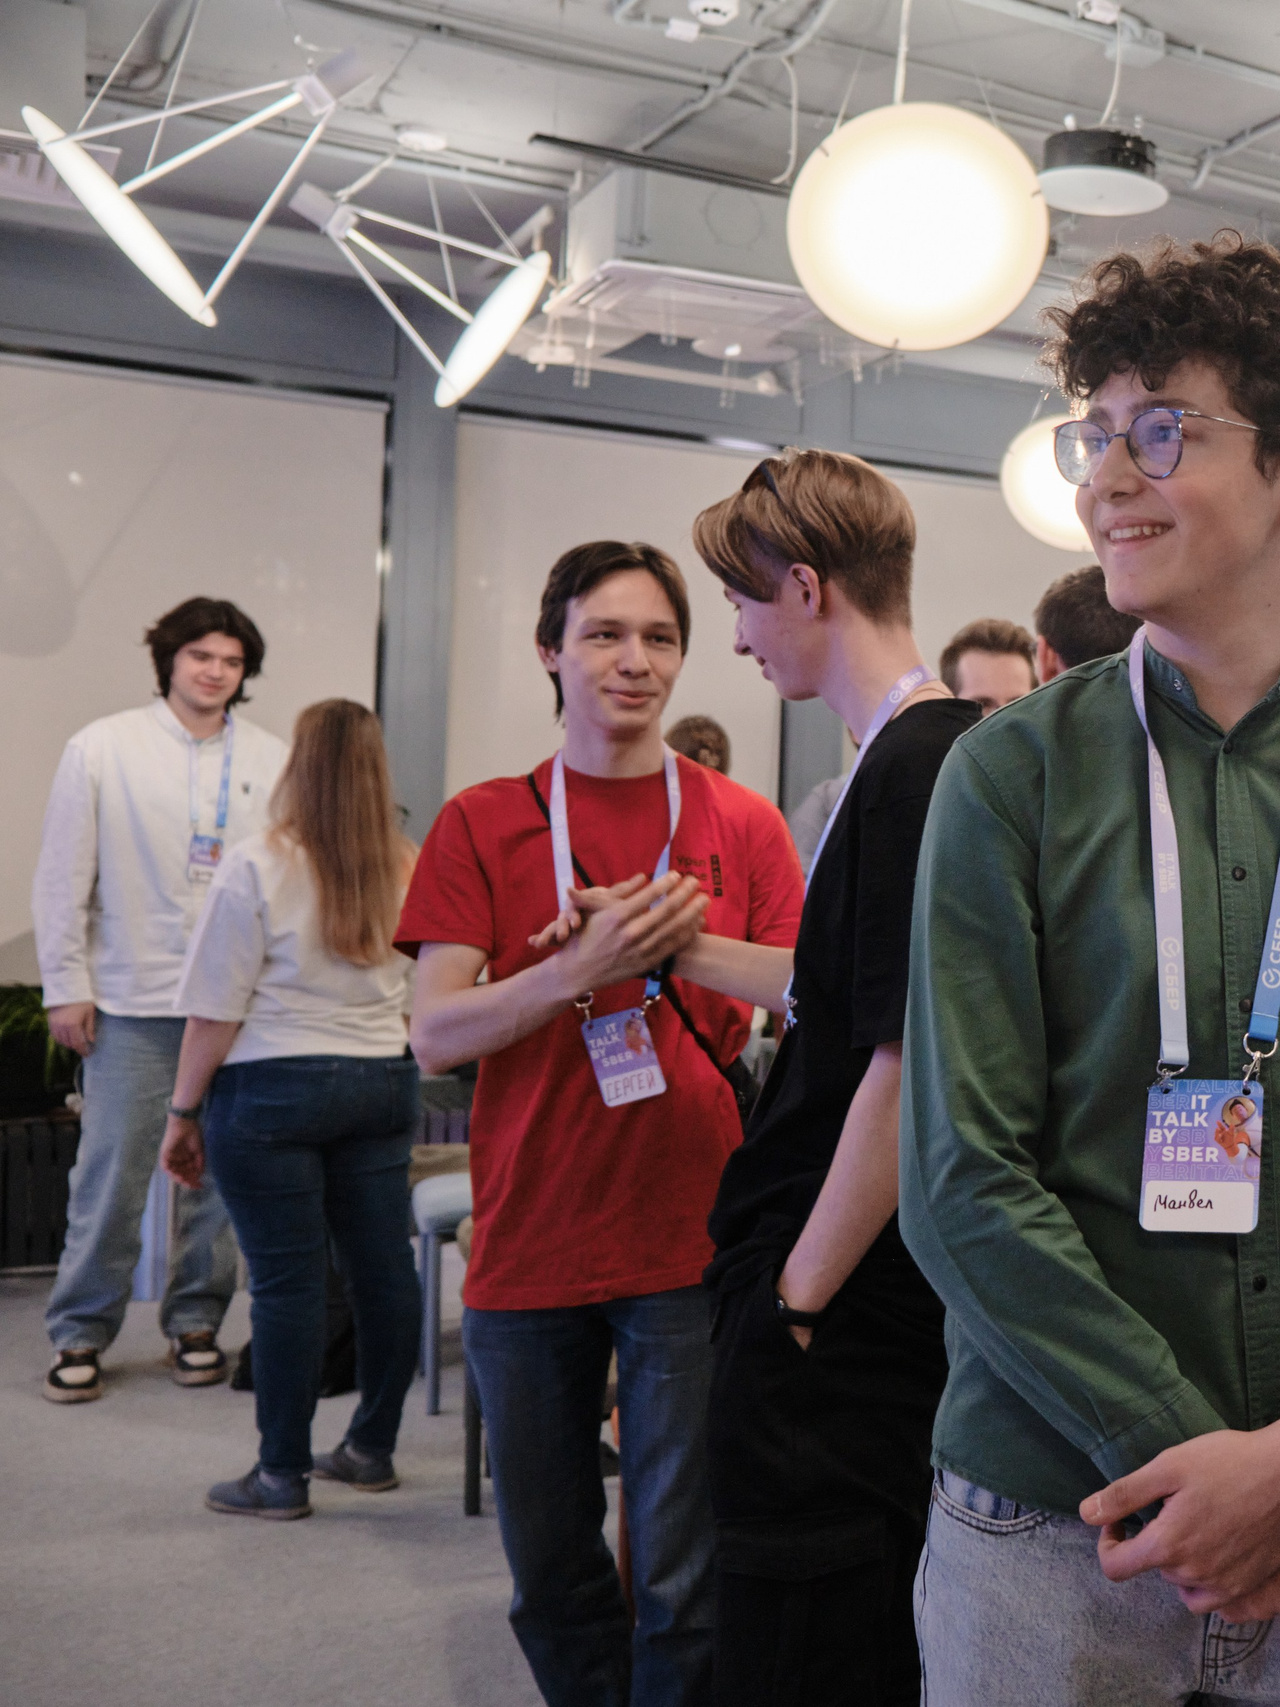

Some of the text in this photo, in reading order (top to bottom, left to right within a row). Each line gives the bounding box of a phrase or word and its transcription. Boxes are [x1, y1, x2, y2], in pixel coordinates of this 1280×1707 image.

[900, 671, 923, 691] СБЕР
[1152, 771, 1167, 814] СБЕР
[1165, 963, 1180, 1011] СБЕР
[605, 1023, 617, 1034] IT
[588, 1034, 622, 1049] TALK
[590, 1048, 606, 1060] BY
[602, 1051, 633, 1068] SBER
[1191, 1094, 1212, 1110] IT
[1151, 1112, 1208, 1127] TALK
[1148, 1128, 1177, 1144] BY
[1162, 1146, 1219, 1162] SBER
[1154, 1189, 1214, 1212] Манвел
